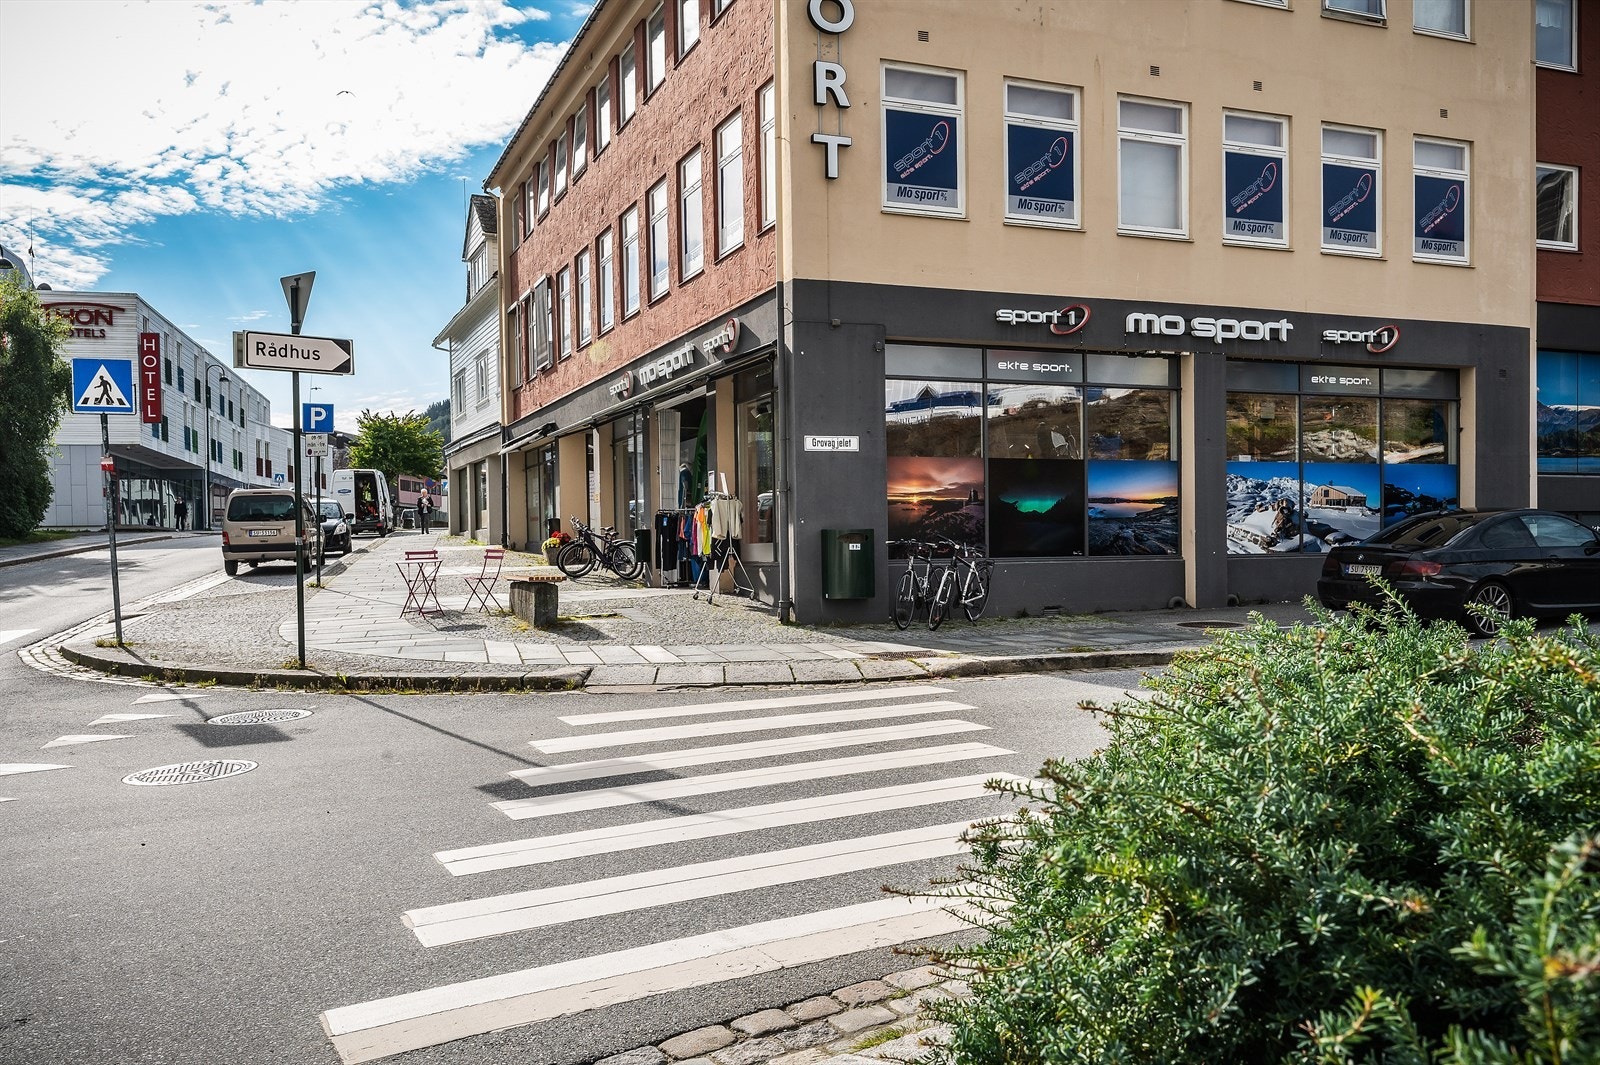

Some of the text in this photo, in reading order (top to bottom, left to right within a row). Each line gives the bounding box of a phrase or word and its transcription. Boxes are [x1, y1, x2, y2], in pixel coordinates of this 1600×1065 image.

[896, 186, 912, 198] Mo
[914, 189, 940, 201] sport
[1018, 198, 1032, 210] Mo
[1033, 201, 1057, 213] sport
[1233, 220, 1246, 231] Mo
[1246, 223, 1268, 234] sport
[1329, 229, 1341, 240] Mo
[1343, 232, 1362, 243] sport
[1421, 240, 1432, 250] Mo
[1433, 242, 1452, 252] sport
[1125, 312, 1294, 344] mo sport
[255, 341, 320, 361] Rådhus
[657, 341, 695, 379] sport
[997, 361, 1029, 371] ekte
[142, 338, 157, 418] HOTEL
[1311, 375, 1337, 384] ekte
[310, 407, 327, 429] P
[812, 438, 852, 450] Grovagjelet
[1350, 565, 1359, 573] SU
